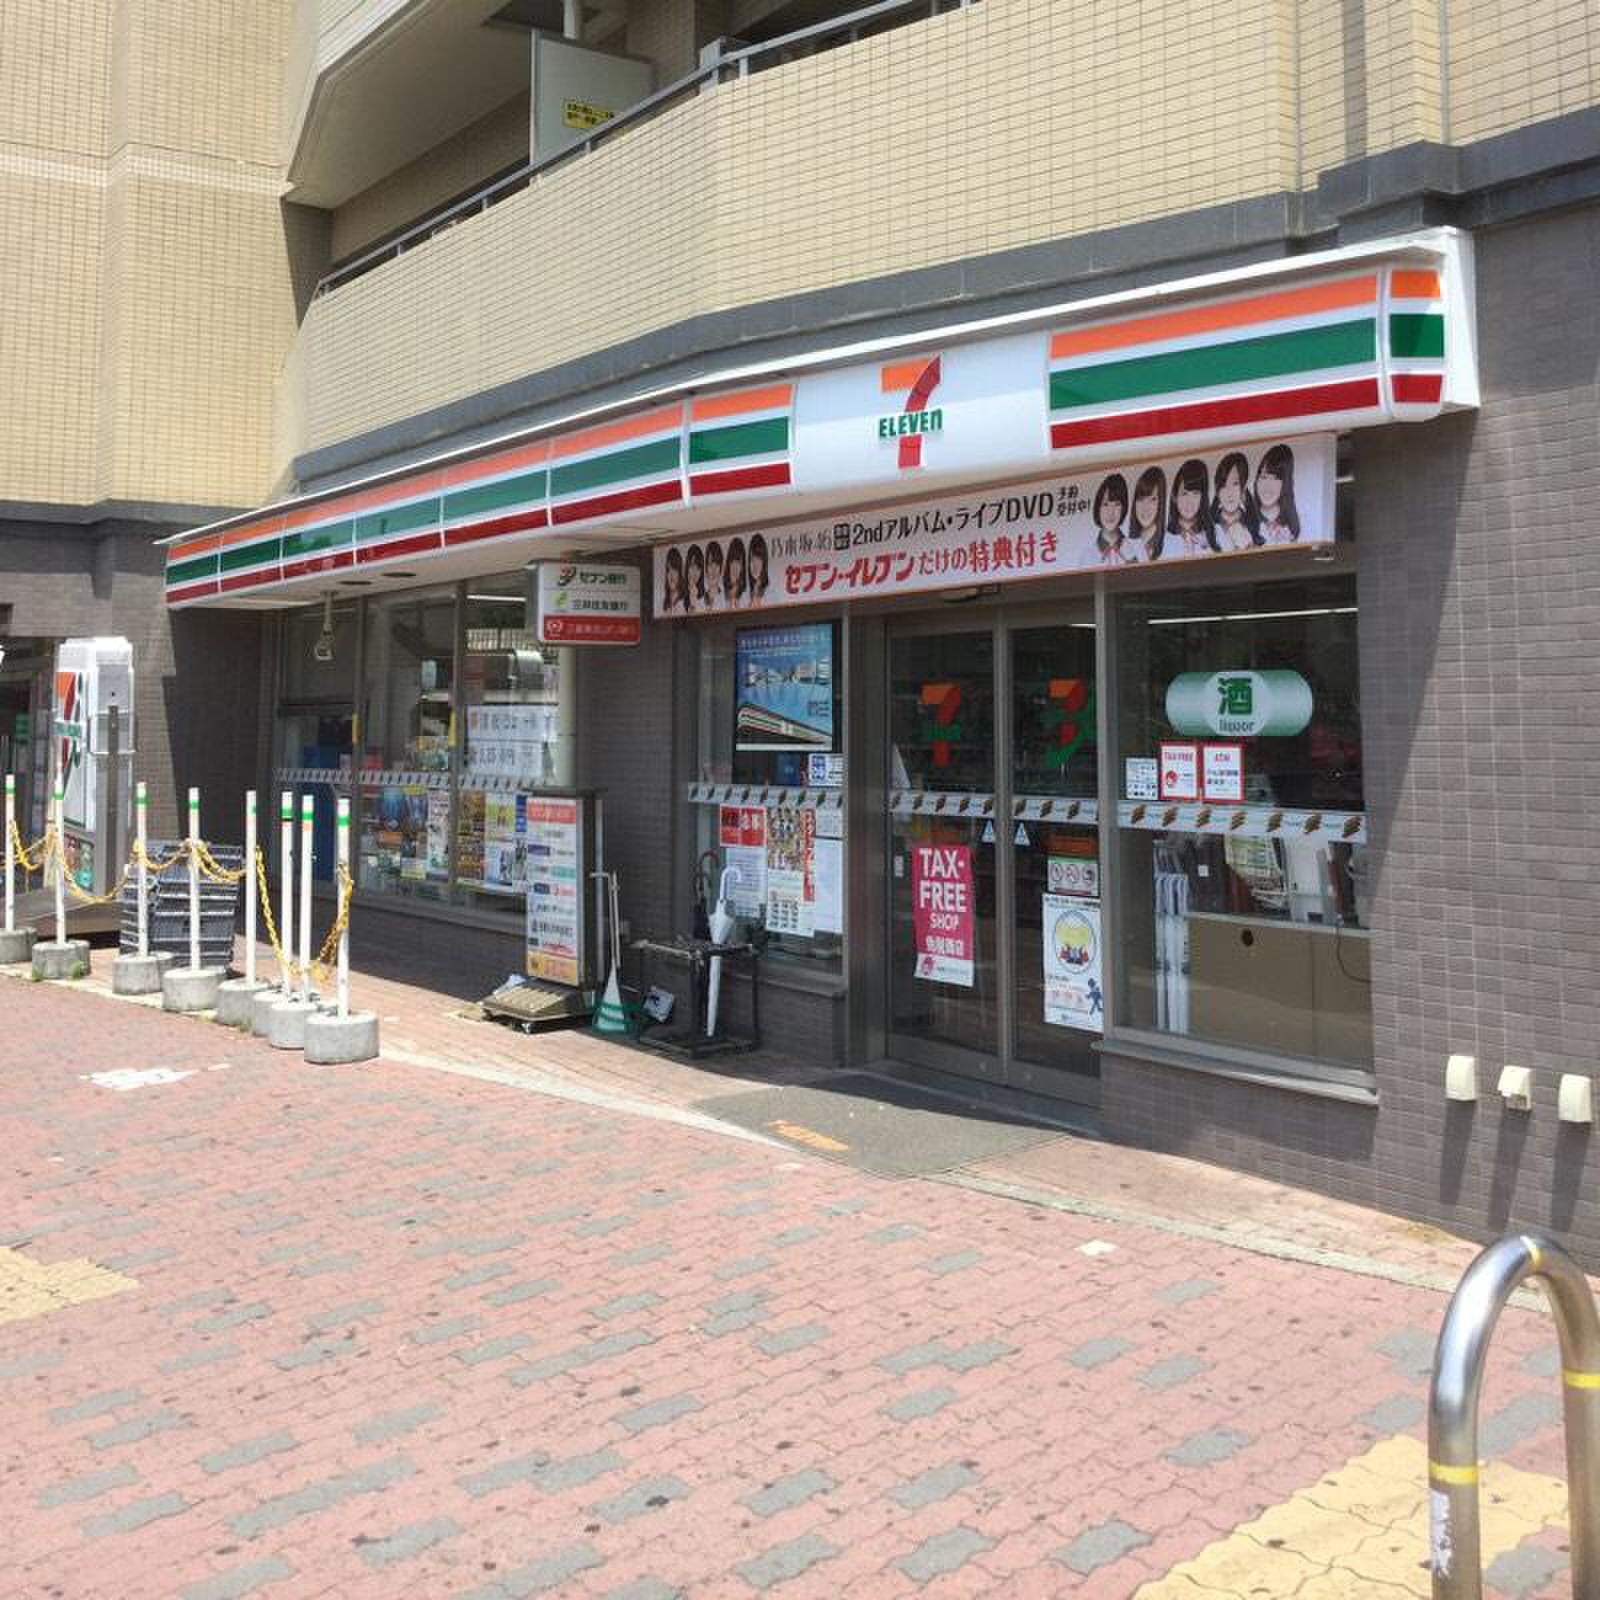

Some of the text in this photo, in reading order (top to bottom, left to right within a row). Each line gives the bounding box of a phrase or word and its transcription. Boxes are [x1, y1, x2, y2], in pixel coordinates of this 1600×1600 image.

[1218, 677, 1253, 715] 酒
[1218, 719, 1255, 733] liquor
[919, 879, 967, 913] FREE
[929, 911, 960, 930] SHOP
